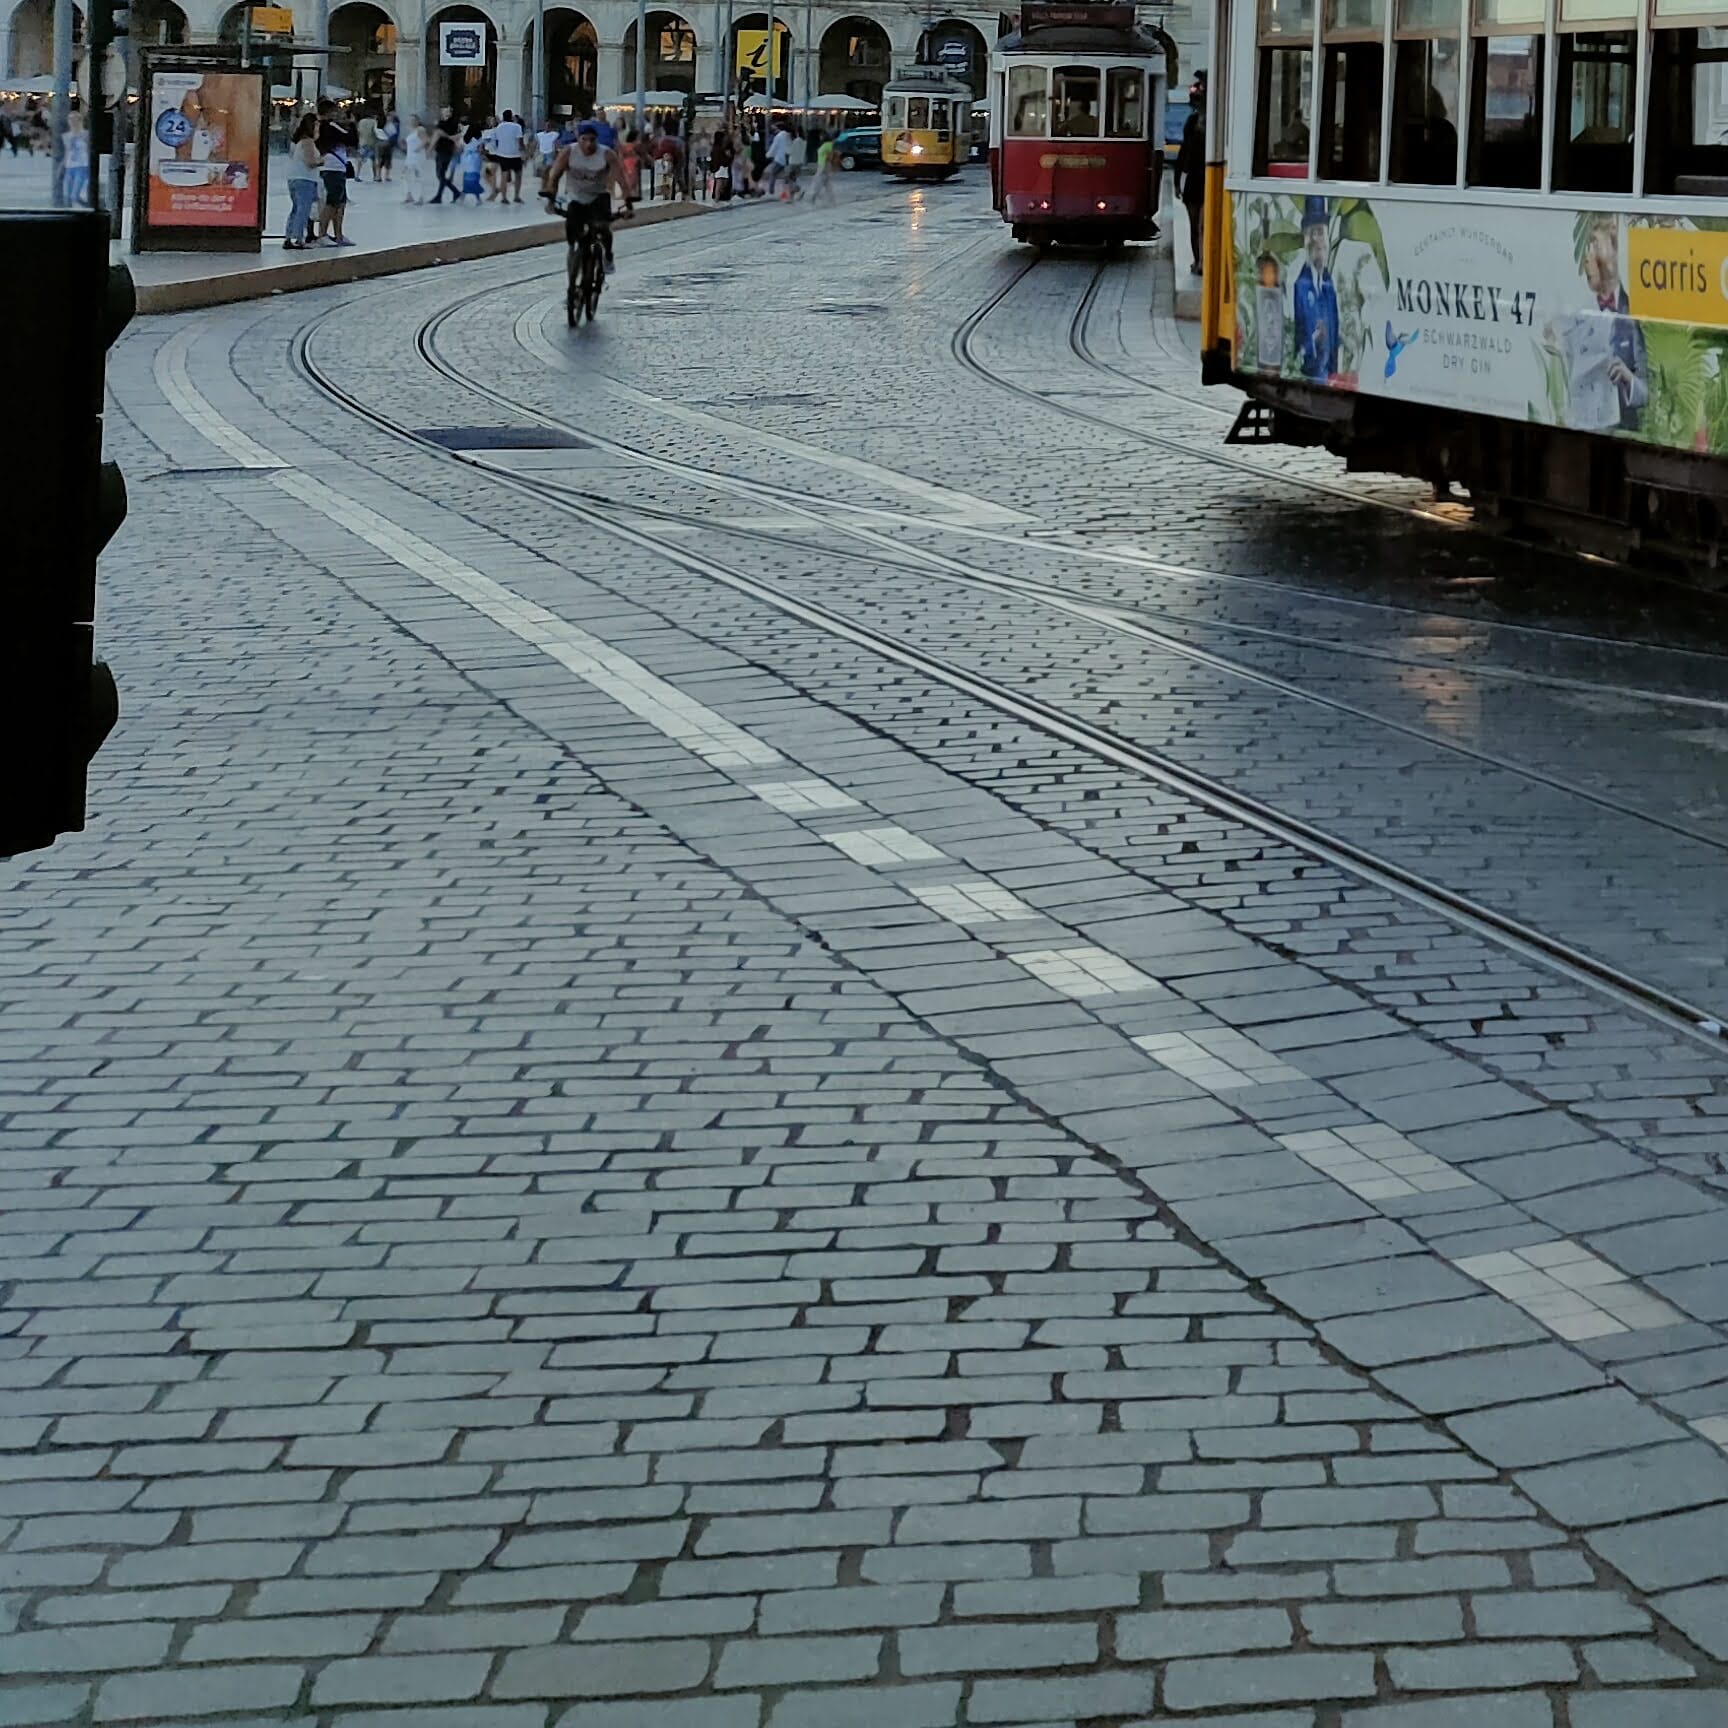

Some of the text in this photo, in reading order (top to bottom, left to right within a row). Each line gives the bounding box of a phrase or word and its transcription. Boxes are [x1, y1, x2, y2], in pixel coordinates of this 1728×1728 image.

[1640, 248, 1707, 293] carris
[1397, 277, 1536, 326] MONKEY 47
[1422, 328, 1512, 354] SCHWARZWALD
[1443, 354, 1491, 373] DRY GIN
